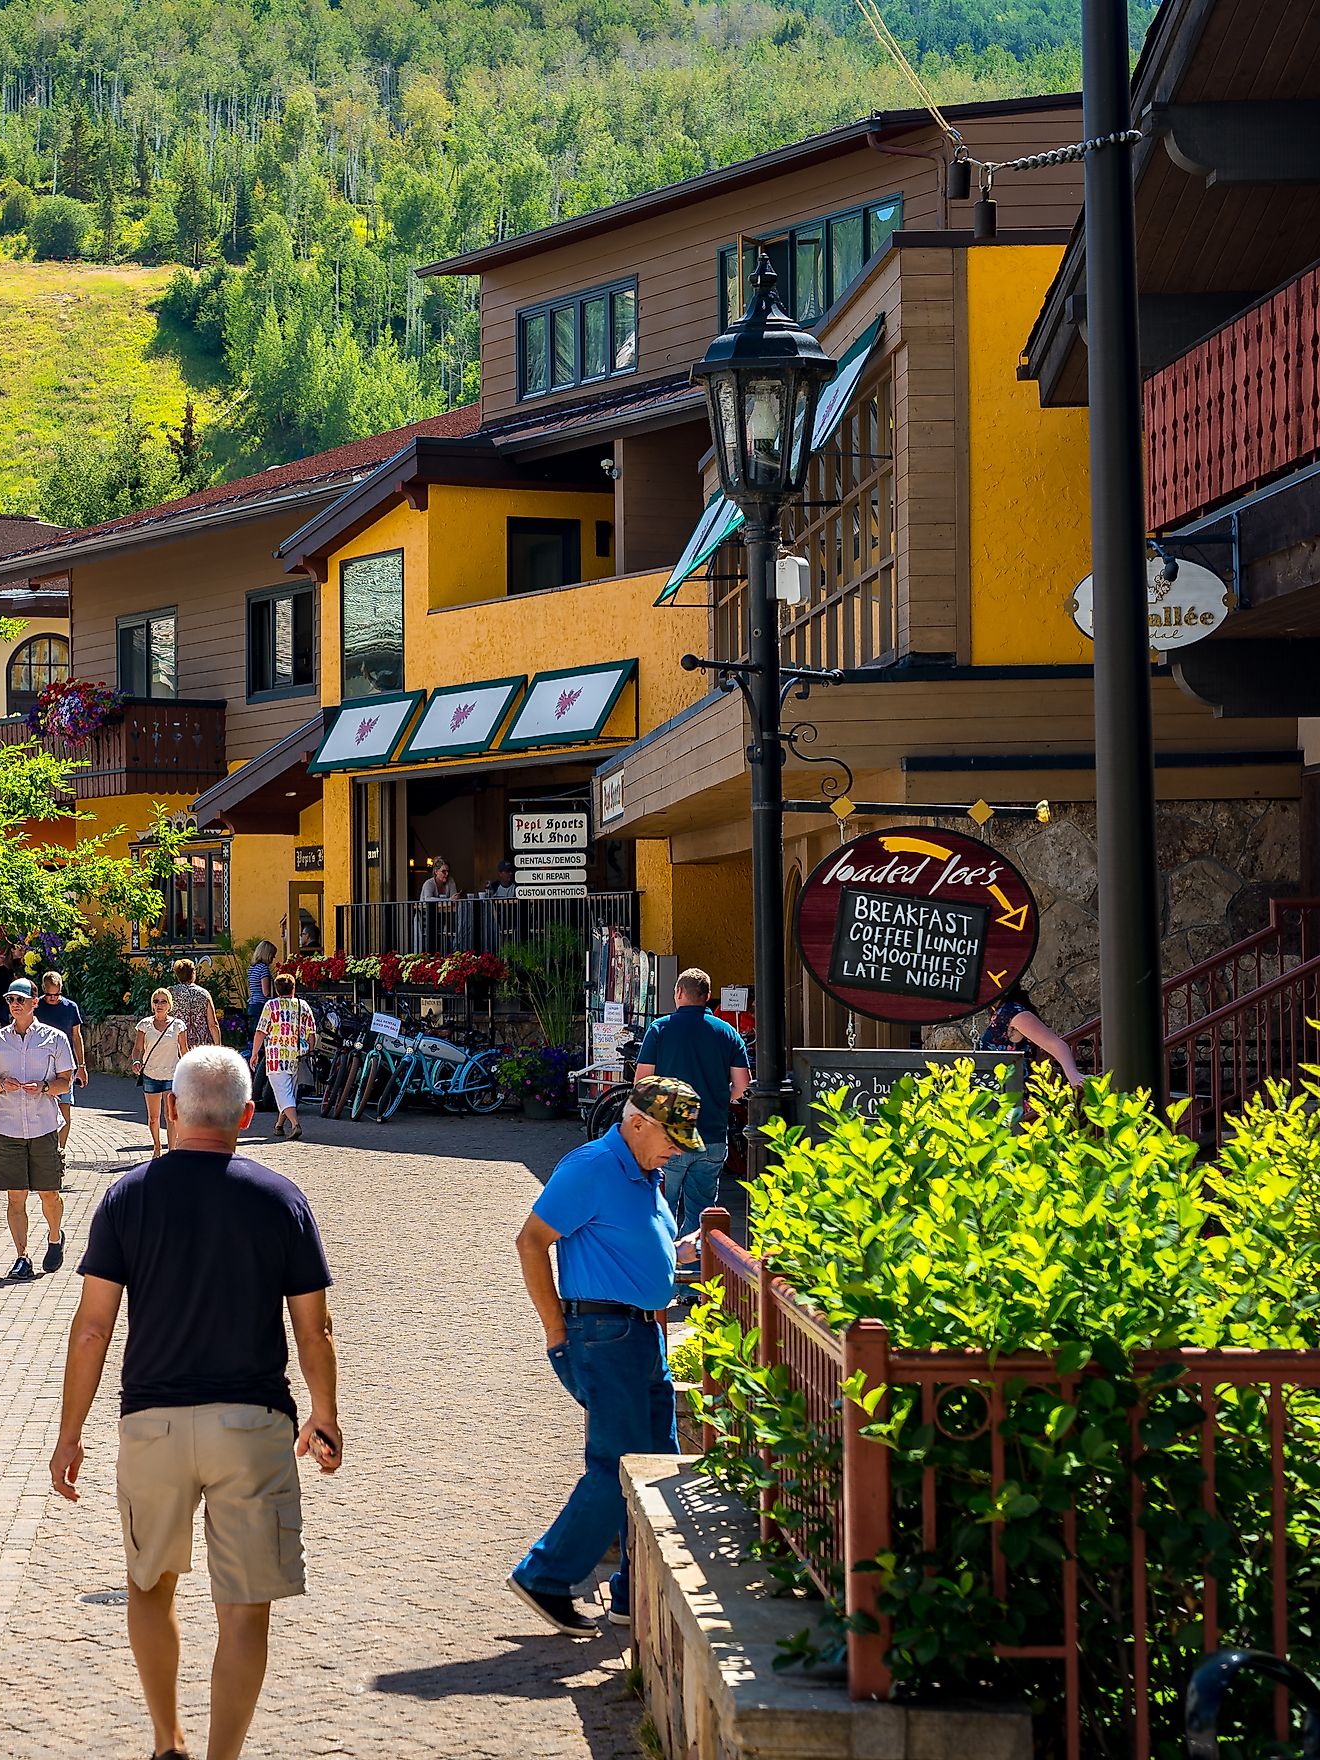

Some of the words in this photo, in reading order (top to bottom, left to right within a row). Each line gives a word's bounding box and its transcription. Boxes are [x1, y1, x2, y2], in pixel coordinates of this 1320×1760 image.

[1148, 606, 1215, 627] allée
[545, 818, 584, 831] Sports
[548, 832, 577, 845] Shop
[520, 856, 581, 865] RENTALS/DEMOS
[546, 872, 570, 880] REPAIR
[518, 888, 545, 897] CUSTOM
[547, 888, 585, 896] ORTHOTICS
[854, 895, 973, 936] BREAKFAST
[849, 922, 914, 948] COFFEE
[925, 937, 979, 956] LUNCH
[862, 943, 967, 975] SMOOTHIES
[843, 960, 892, 982] LATE
[905, 970, 963, 992] NIGHT
